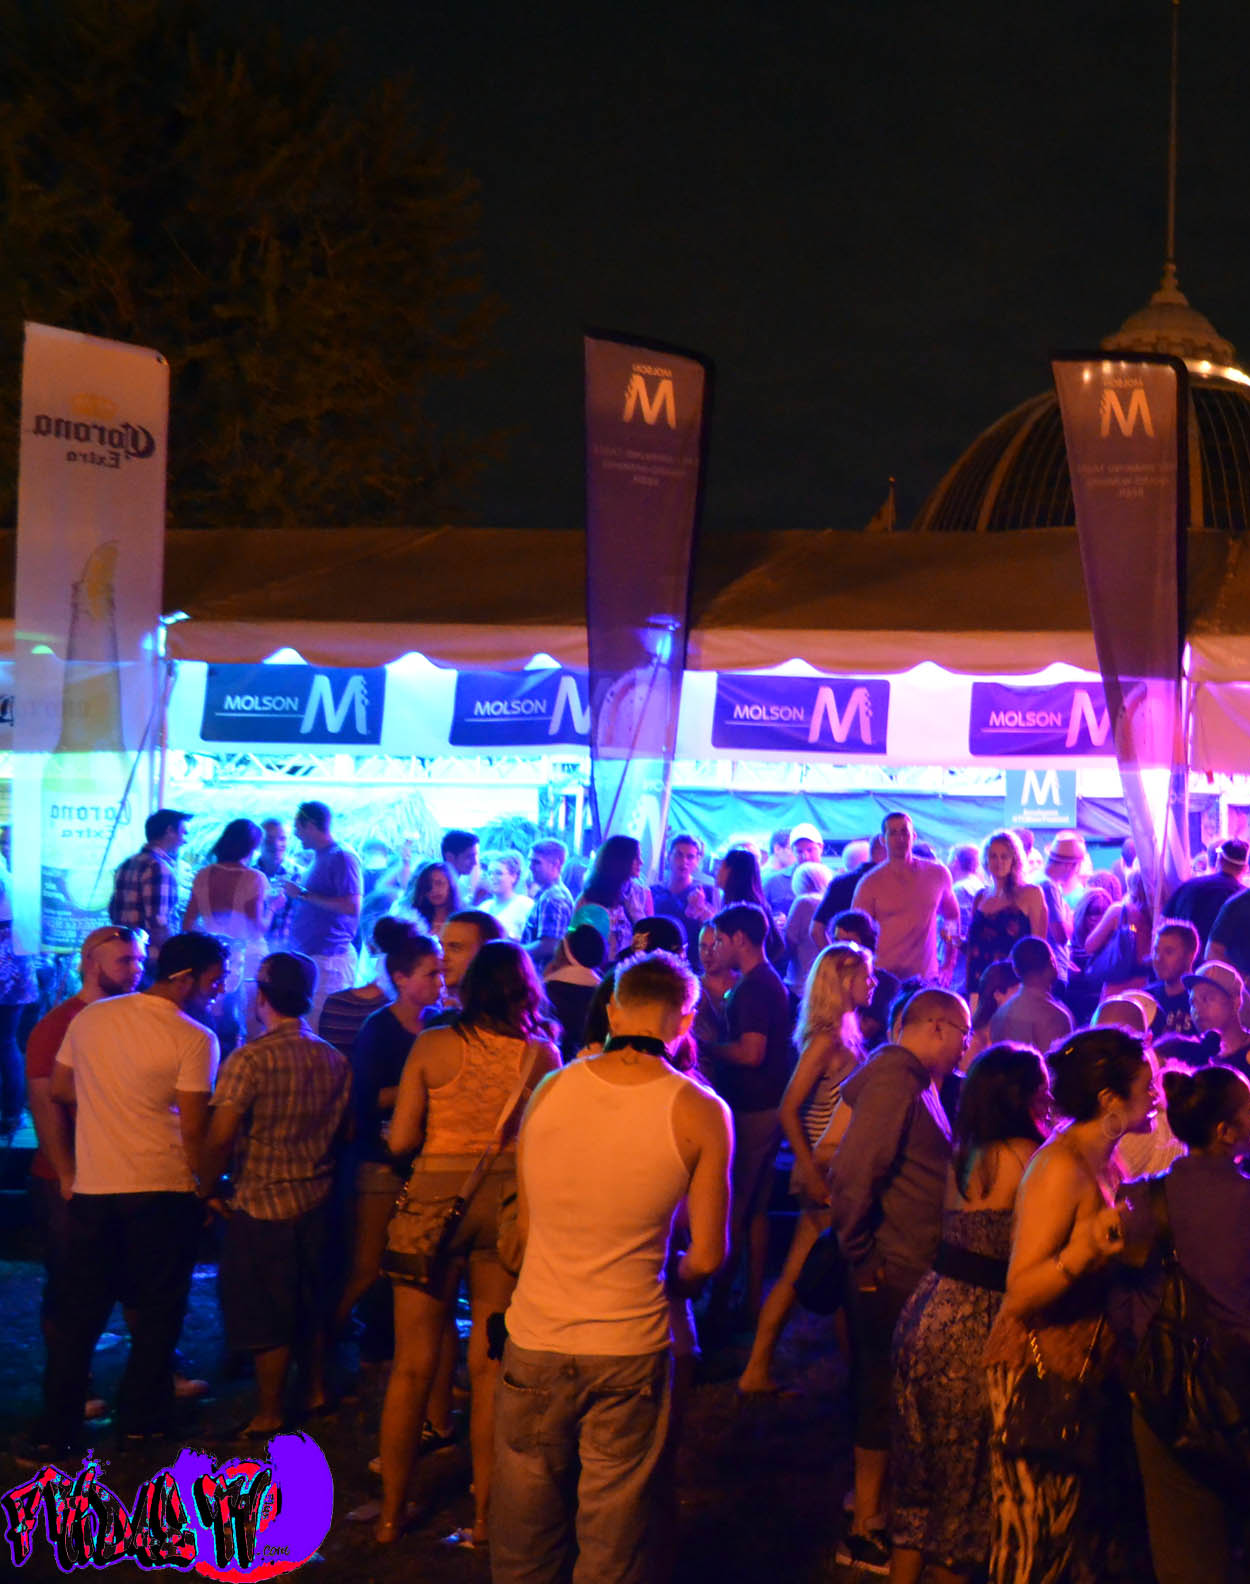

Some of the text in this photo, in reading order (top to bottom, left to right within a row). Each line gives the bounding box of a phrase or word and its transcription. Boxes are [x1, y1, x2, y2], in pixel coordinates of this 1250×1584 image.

[224, 674, 369, 735] MOLSON M
[474, 699, 547, 716] MOLSON
[733, 686, 873, 744] MOLSON M
[989, 711, 1062, 728] MOLSON
